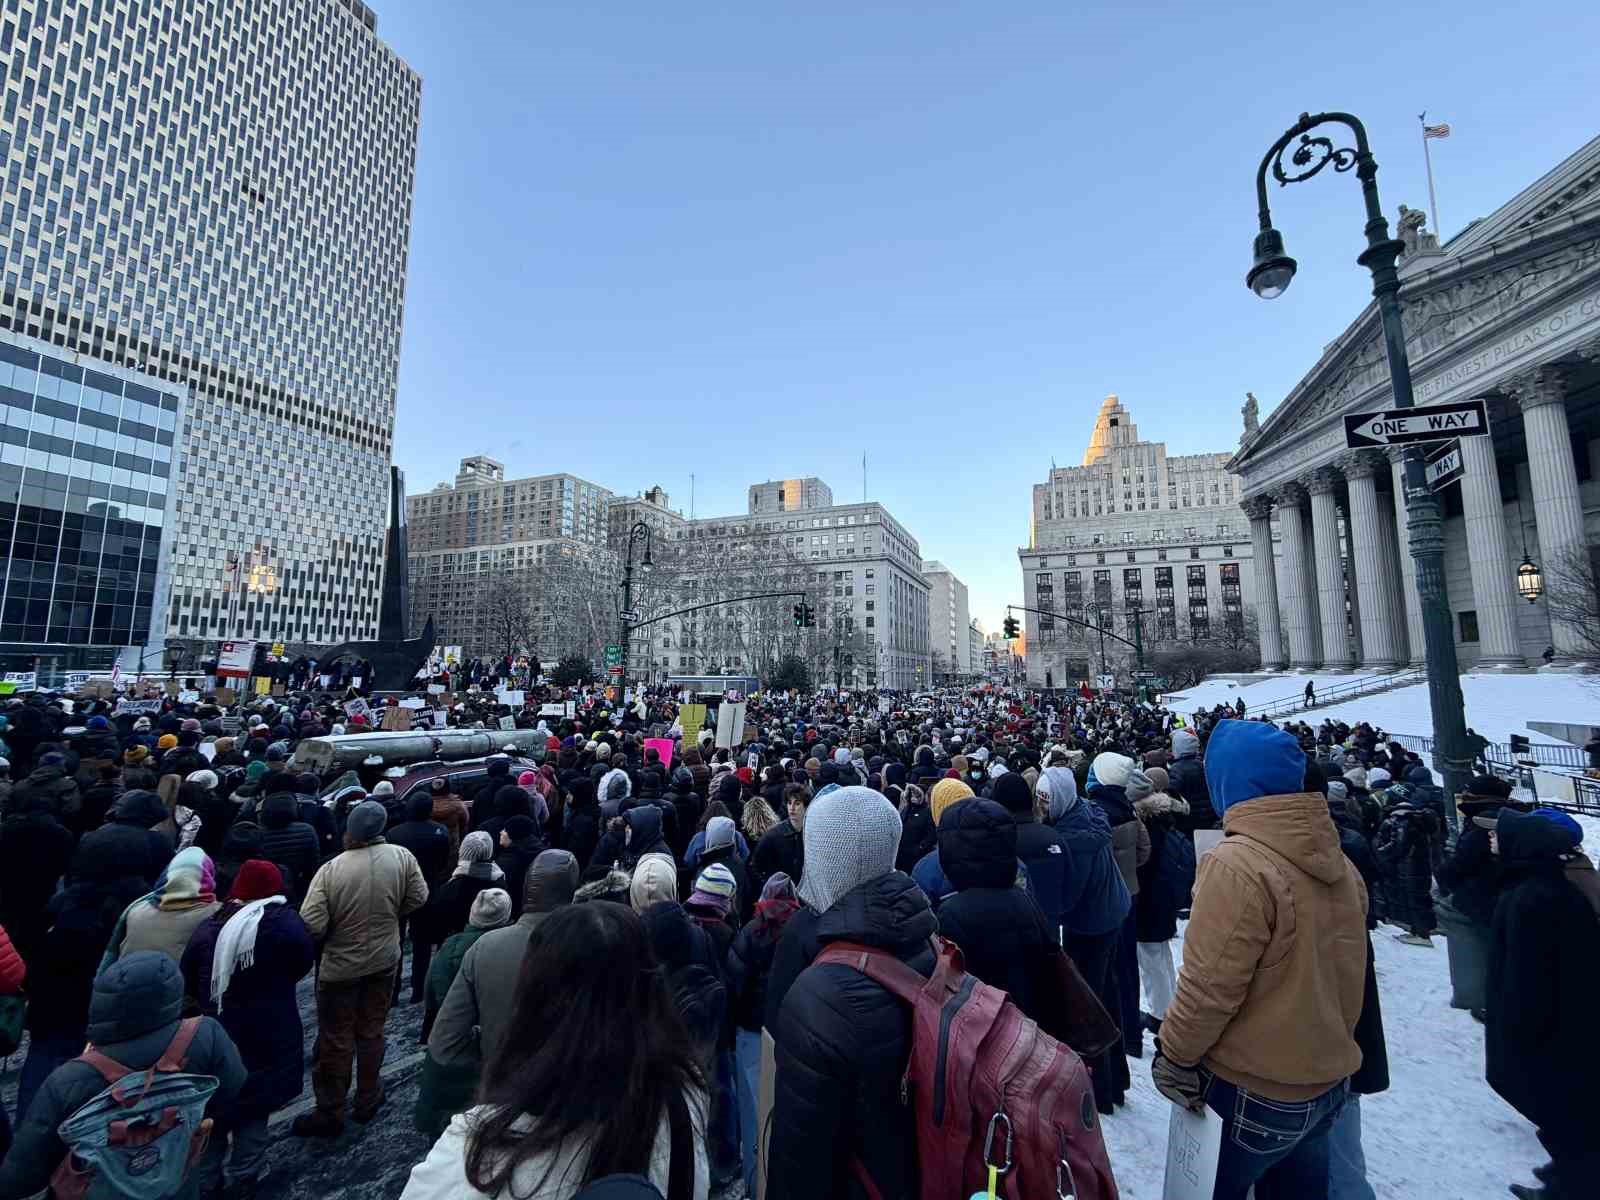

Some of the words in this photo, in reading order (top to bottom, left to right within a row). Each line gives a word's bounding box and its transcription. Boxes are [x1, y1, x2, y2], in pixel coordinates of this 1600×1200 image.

[1494, 327, 1543, 361] PILLAR
[1549, 310, 1573, 332] OF
[1371, 419, 1408, 436] ONE
[1428, 412, 1469, 430] WAY
[1434, 456, 1456, 476] WAY
